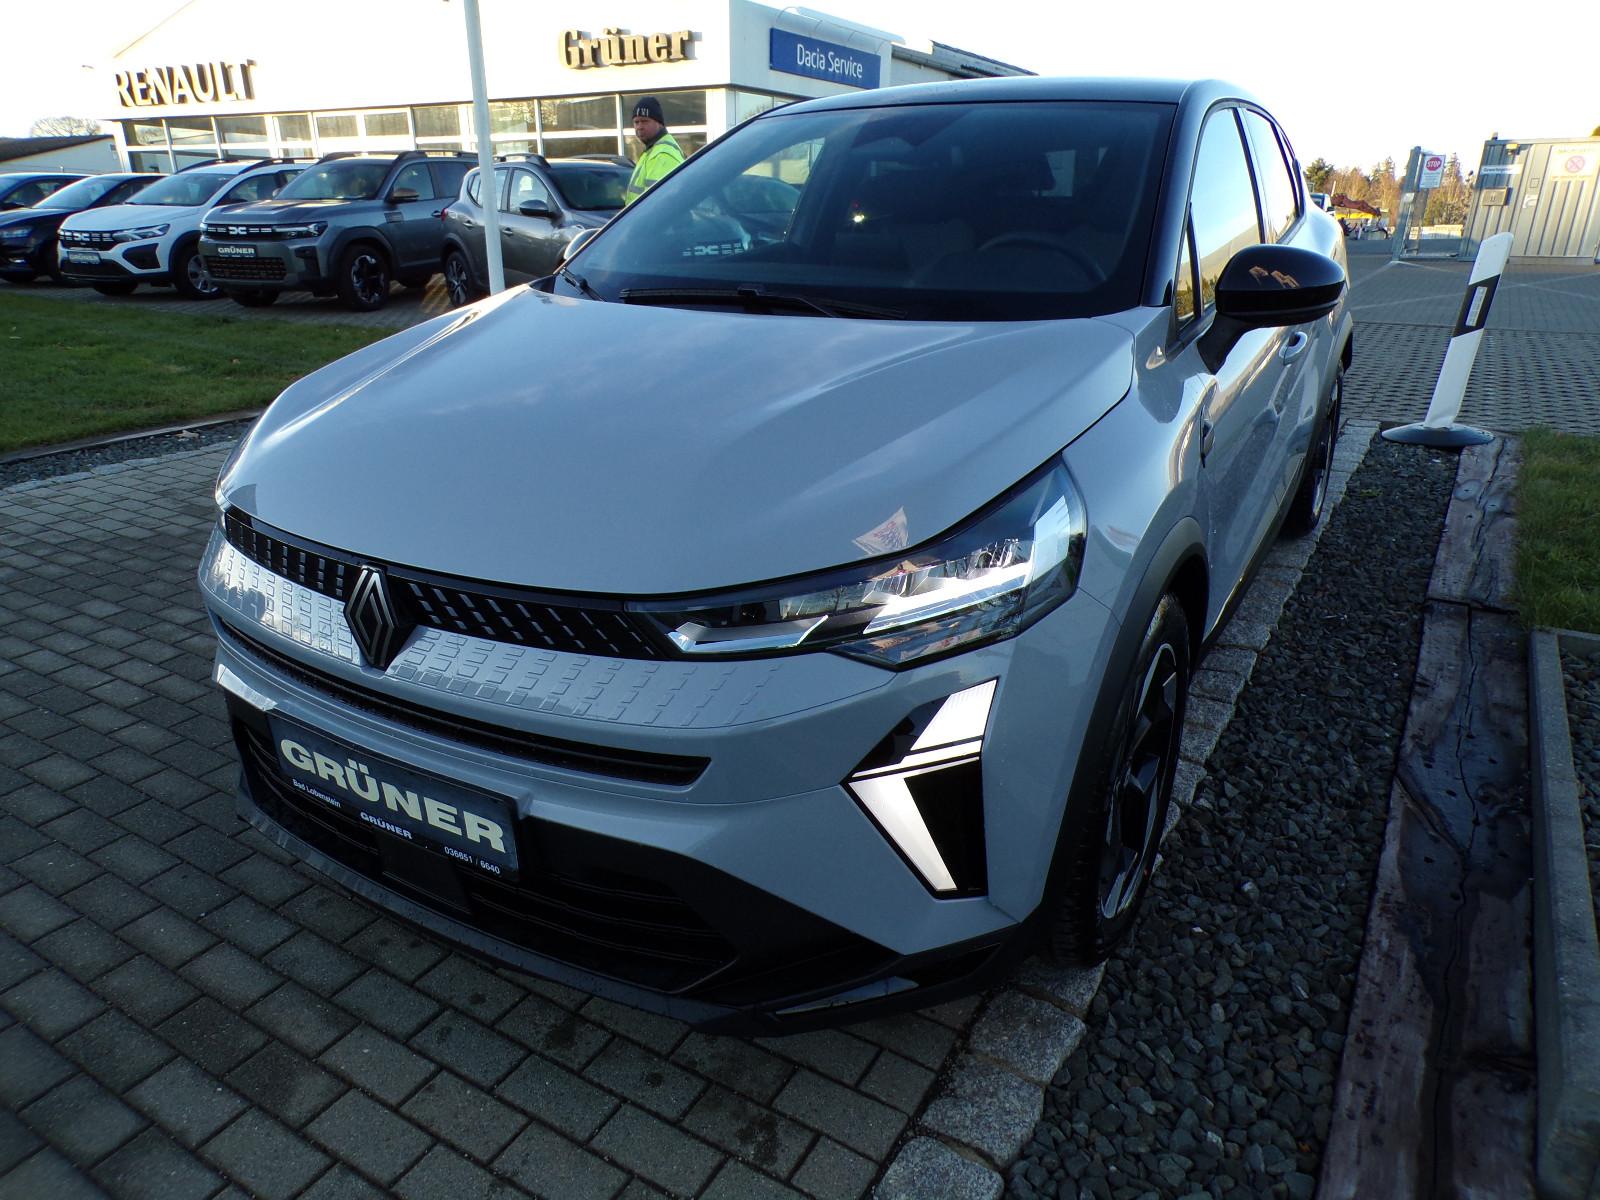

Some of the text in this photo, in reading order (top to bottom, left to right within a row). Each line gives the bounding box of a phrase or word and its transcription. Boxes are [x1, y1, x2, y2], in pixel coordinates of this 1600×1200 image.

[558, 27, 691, 69] Grüner
[796, 43, 863, 79] Dacia Service
[115, 60, 256, 107] RENAULT
[1426, 160, 1441, 168] STOP
[217, 246, 255, 254] GRÜNER
[281, 739, 506, 854] GRÜNER
[292, 778, 307, 791] Bad
[360, 811, 413, 839] GRÜNER
[480, 860, 501, 875] 6640
